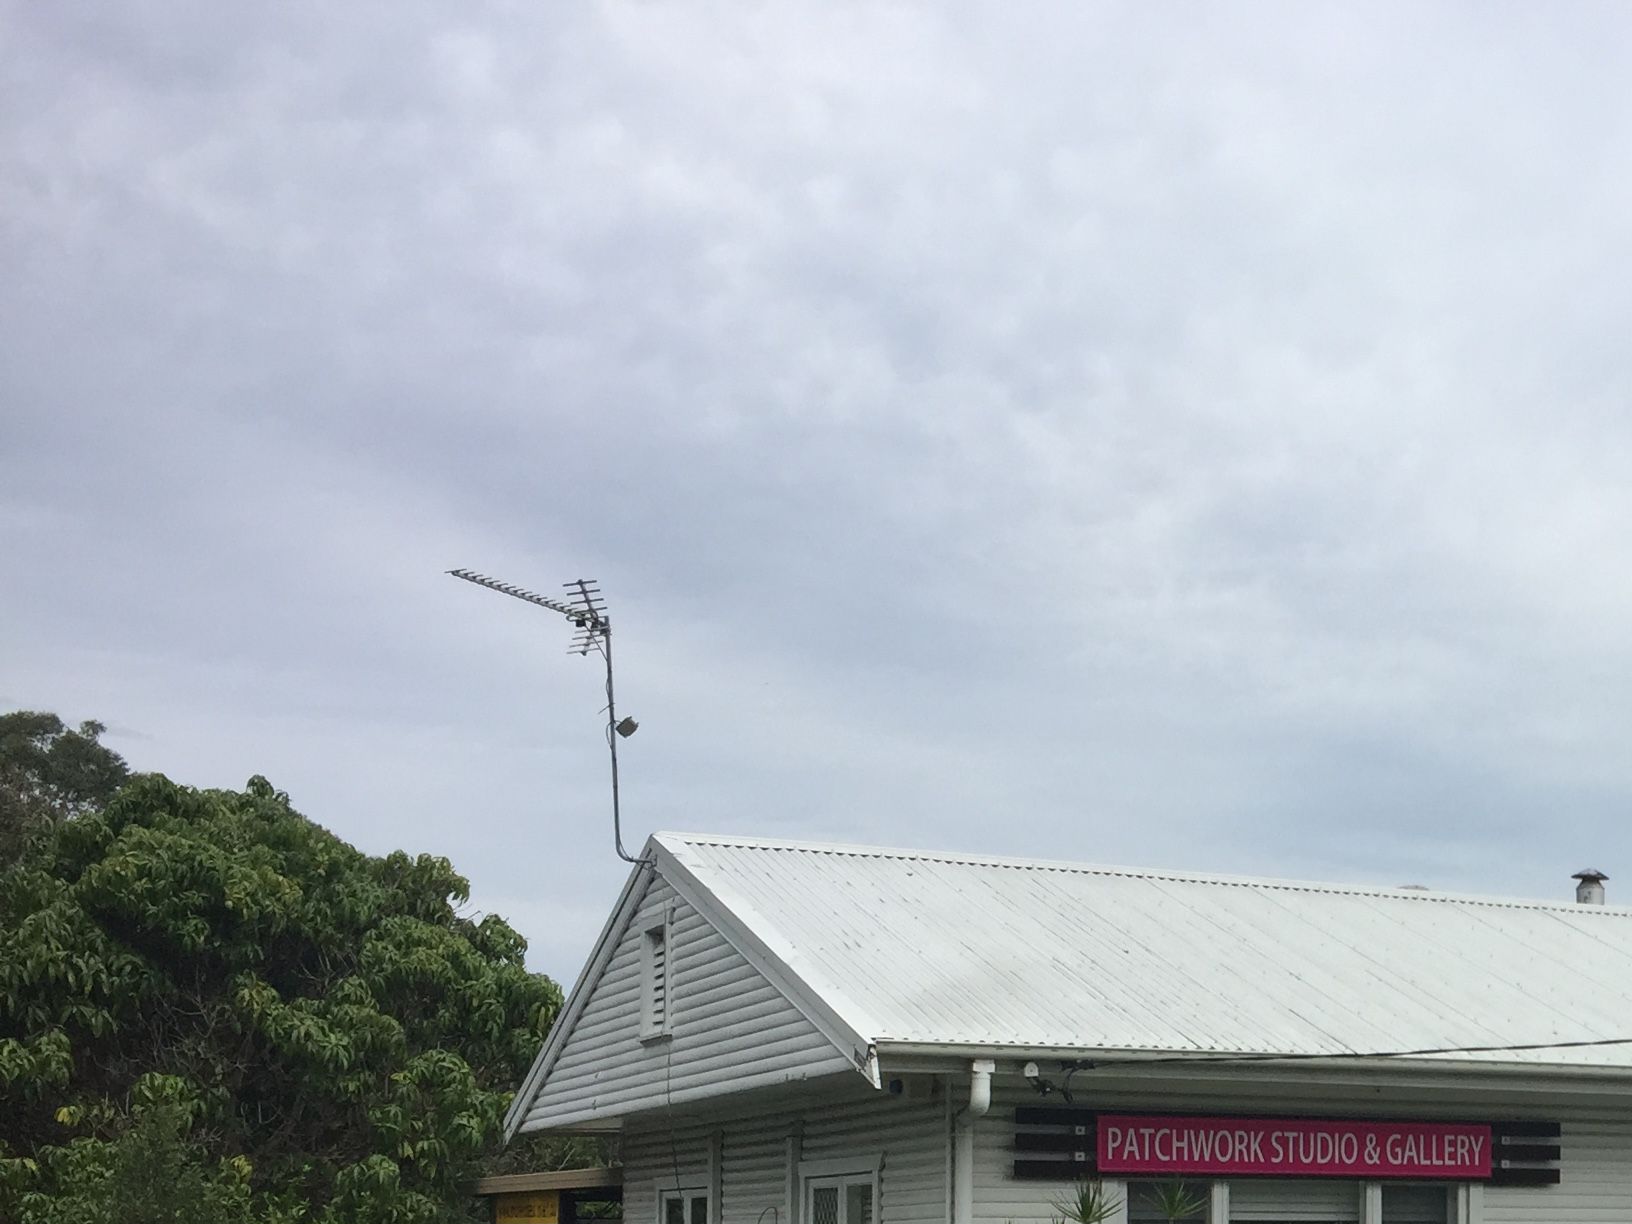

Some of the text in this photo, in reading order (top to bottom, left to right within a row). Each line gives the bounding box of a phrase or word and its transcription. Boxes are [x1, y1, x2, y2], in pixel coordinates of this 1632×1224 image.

[1107, 1127, 1485, 1167] PATCHWORK STUDIO & GALLERY
